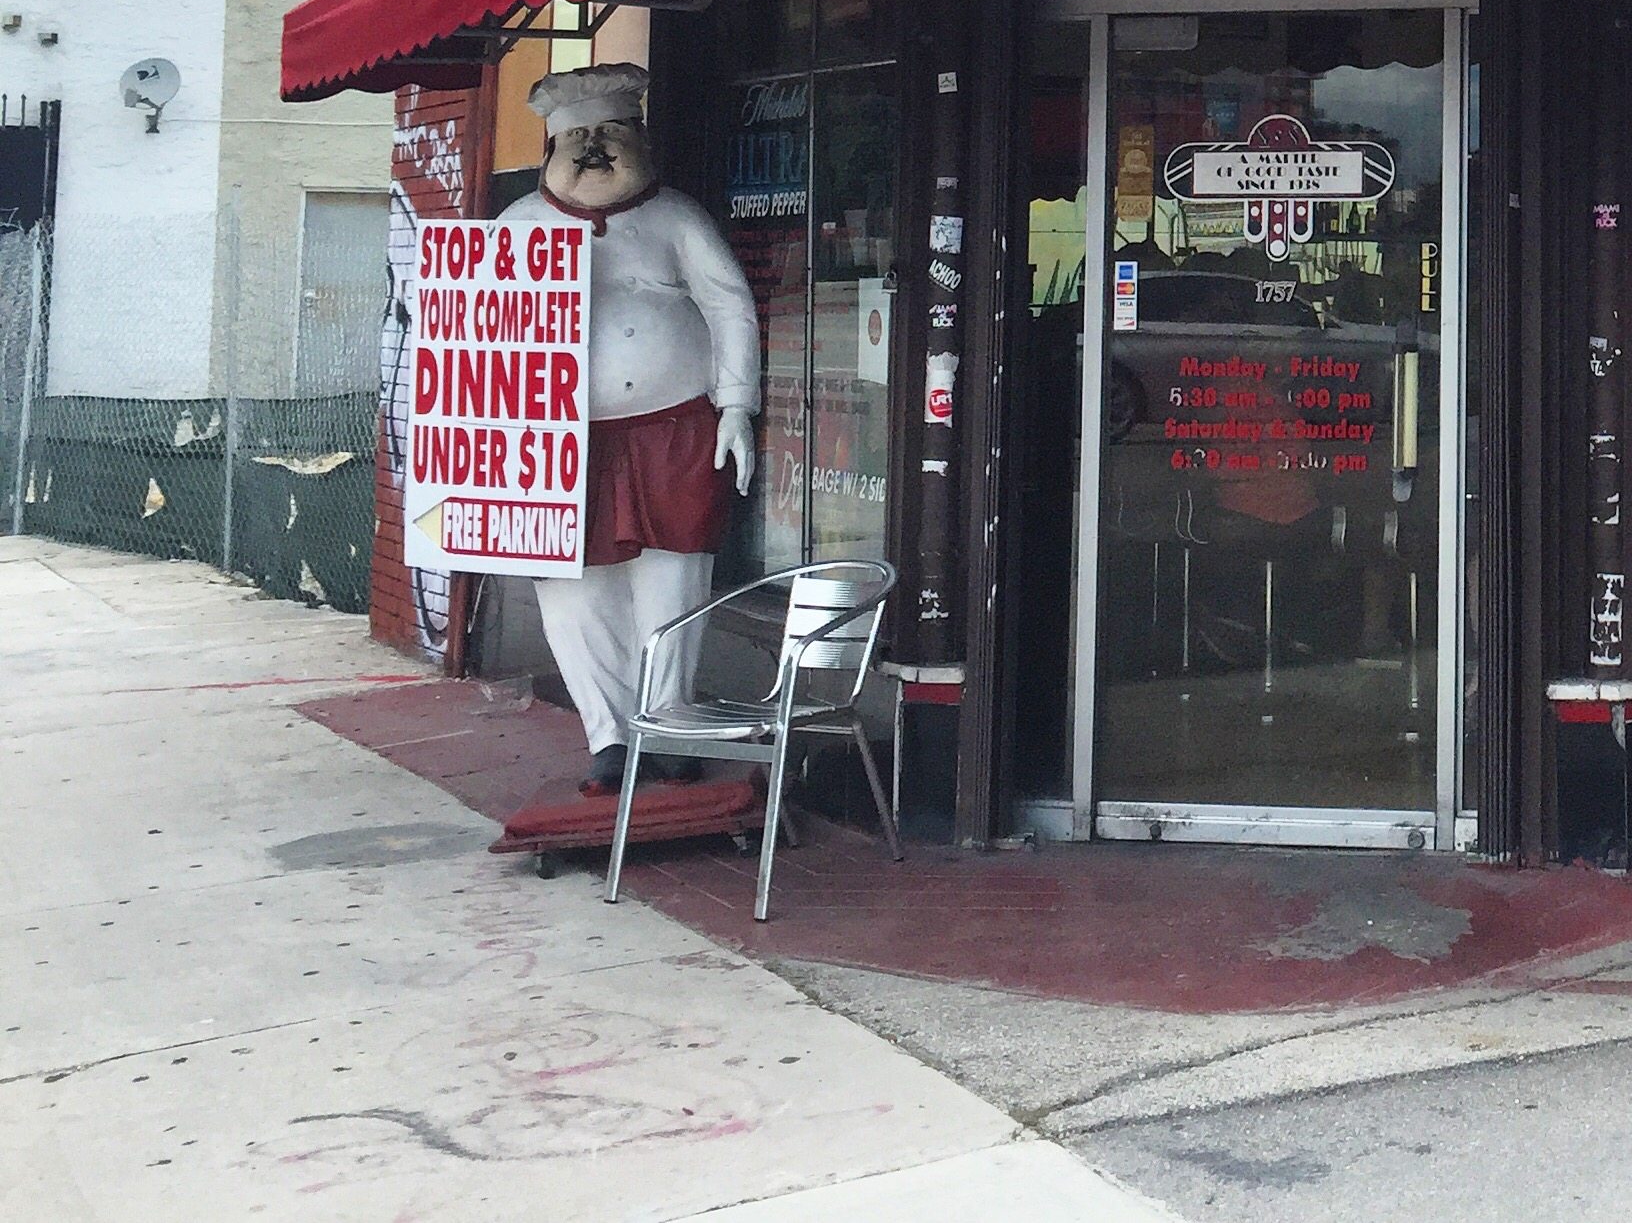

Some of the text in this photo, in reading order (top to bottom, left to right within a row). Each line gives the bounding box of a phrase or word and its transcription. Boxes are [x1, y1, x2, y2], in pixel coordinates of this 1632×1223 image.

[1217, 166, 1341, 177] OF GOOD TASTE
[1239, 153, 1318, 164] A MATTER
[1237, 180, 1321, 190] SINCE 1938
[731, 193, 770, 219] STUFFED
[419, 226, 583, 281] STOP & GET
[1421, 243, 1438, 312] PULL
[1255, 280, 1297, 303] 1757
[419, 288, 581, 345] YOUR COMPLETE
[1179, 356, 1267, 380] Monday
[1290, 356, 1361, 382] Friday
[414, 348, 580, 422] DINNER
[1224, 391, 1258, 408] am
[1288, 388, 1331, 408] :00
[1338, 391, 1371, 412] pm
[1164, 417, 1374, 445] Saturday & Sunday
[413, 424, 580, 496] UNDER $10
[1226, 453, 1260, 470] am
[1333, 453, 1368, 475] pm
[859, 474, 868, 499] 2
[442, 500, 577, 557] FREE PARKING
